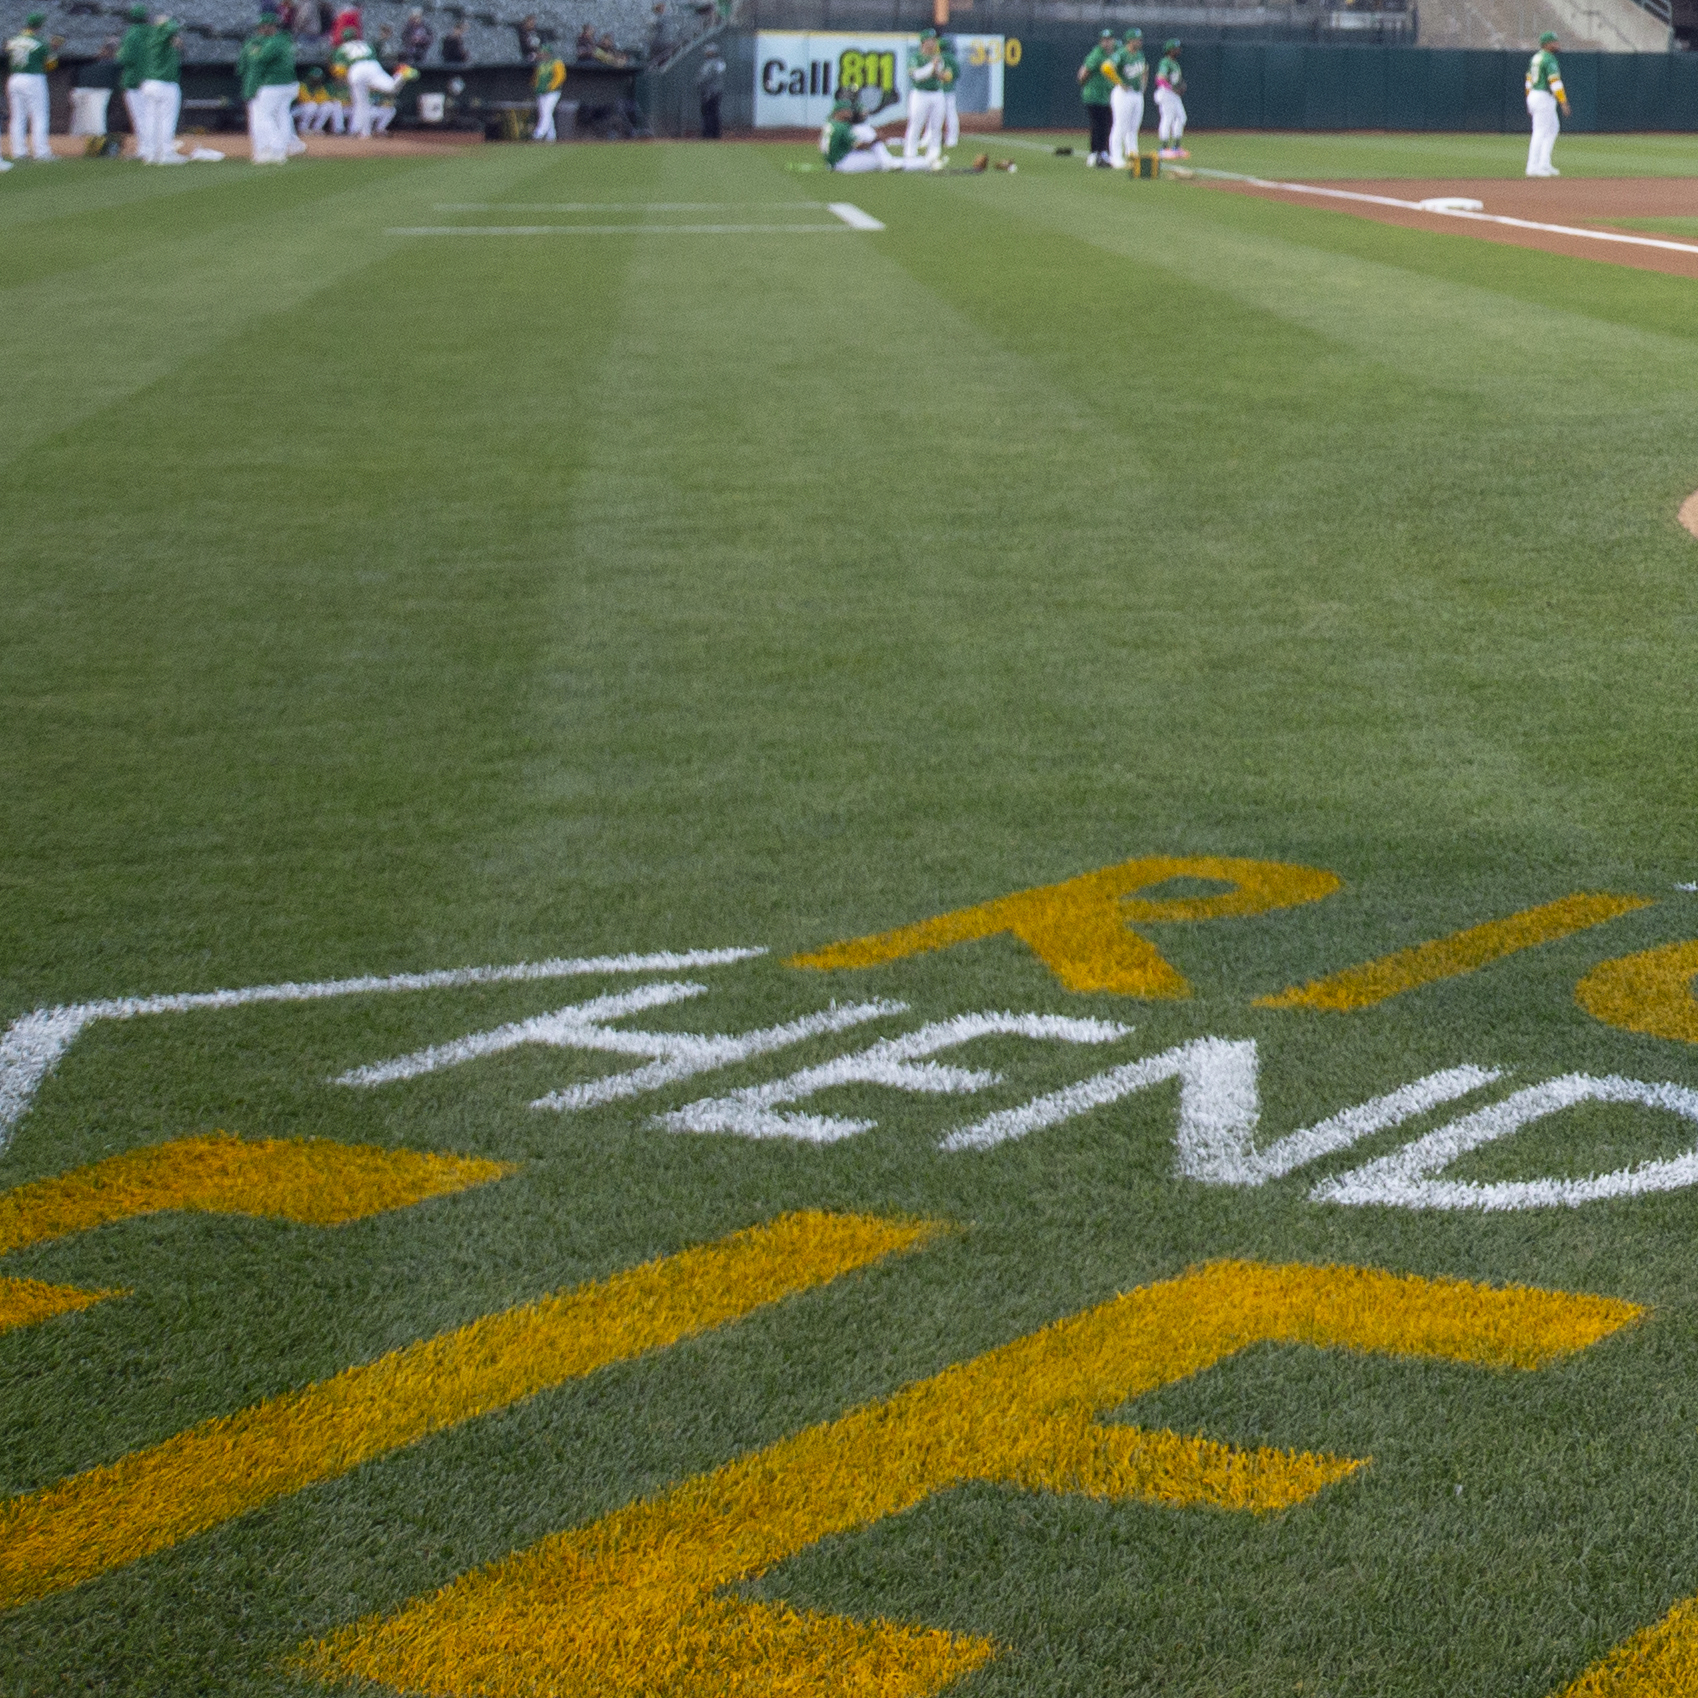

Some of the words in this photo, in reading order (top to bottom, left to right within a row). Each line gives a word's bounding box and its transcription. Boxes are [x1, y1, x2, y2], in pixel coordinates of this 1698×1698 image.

[968, 37, 1023, 67] 330
[762, 59, 831, 96] Call
[839, 50, 895, 92] 811
